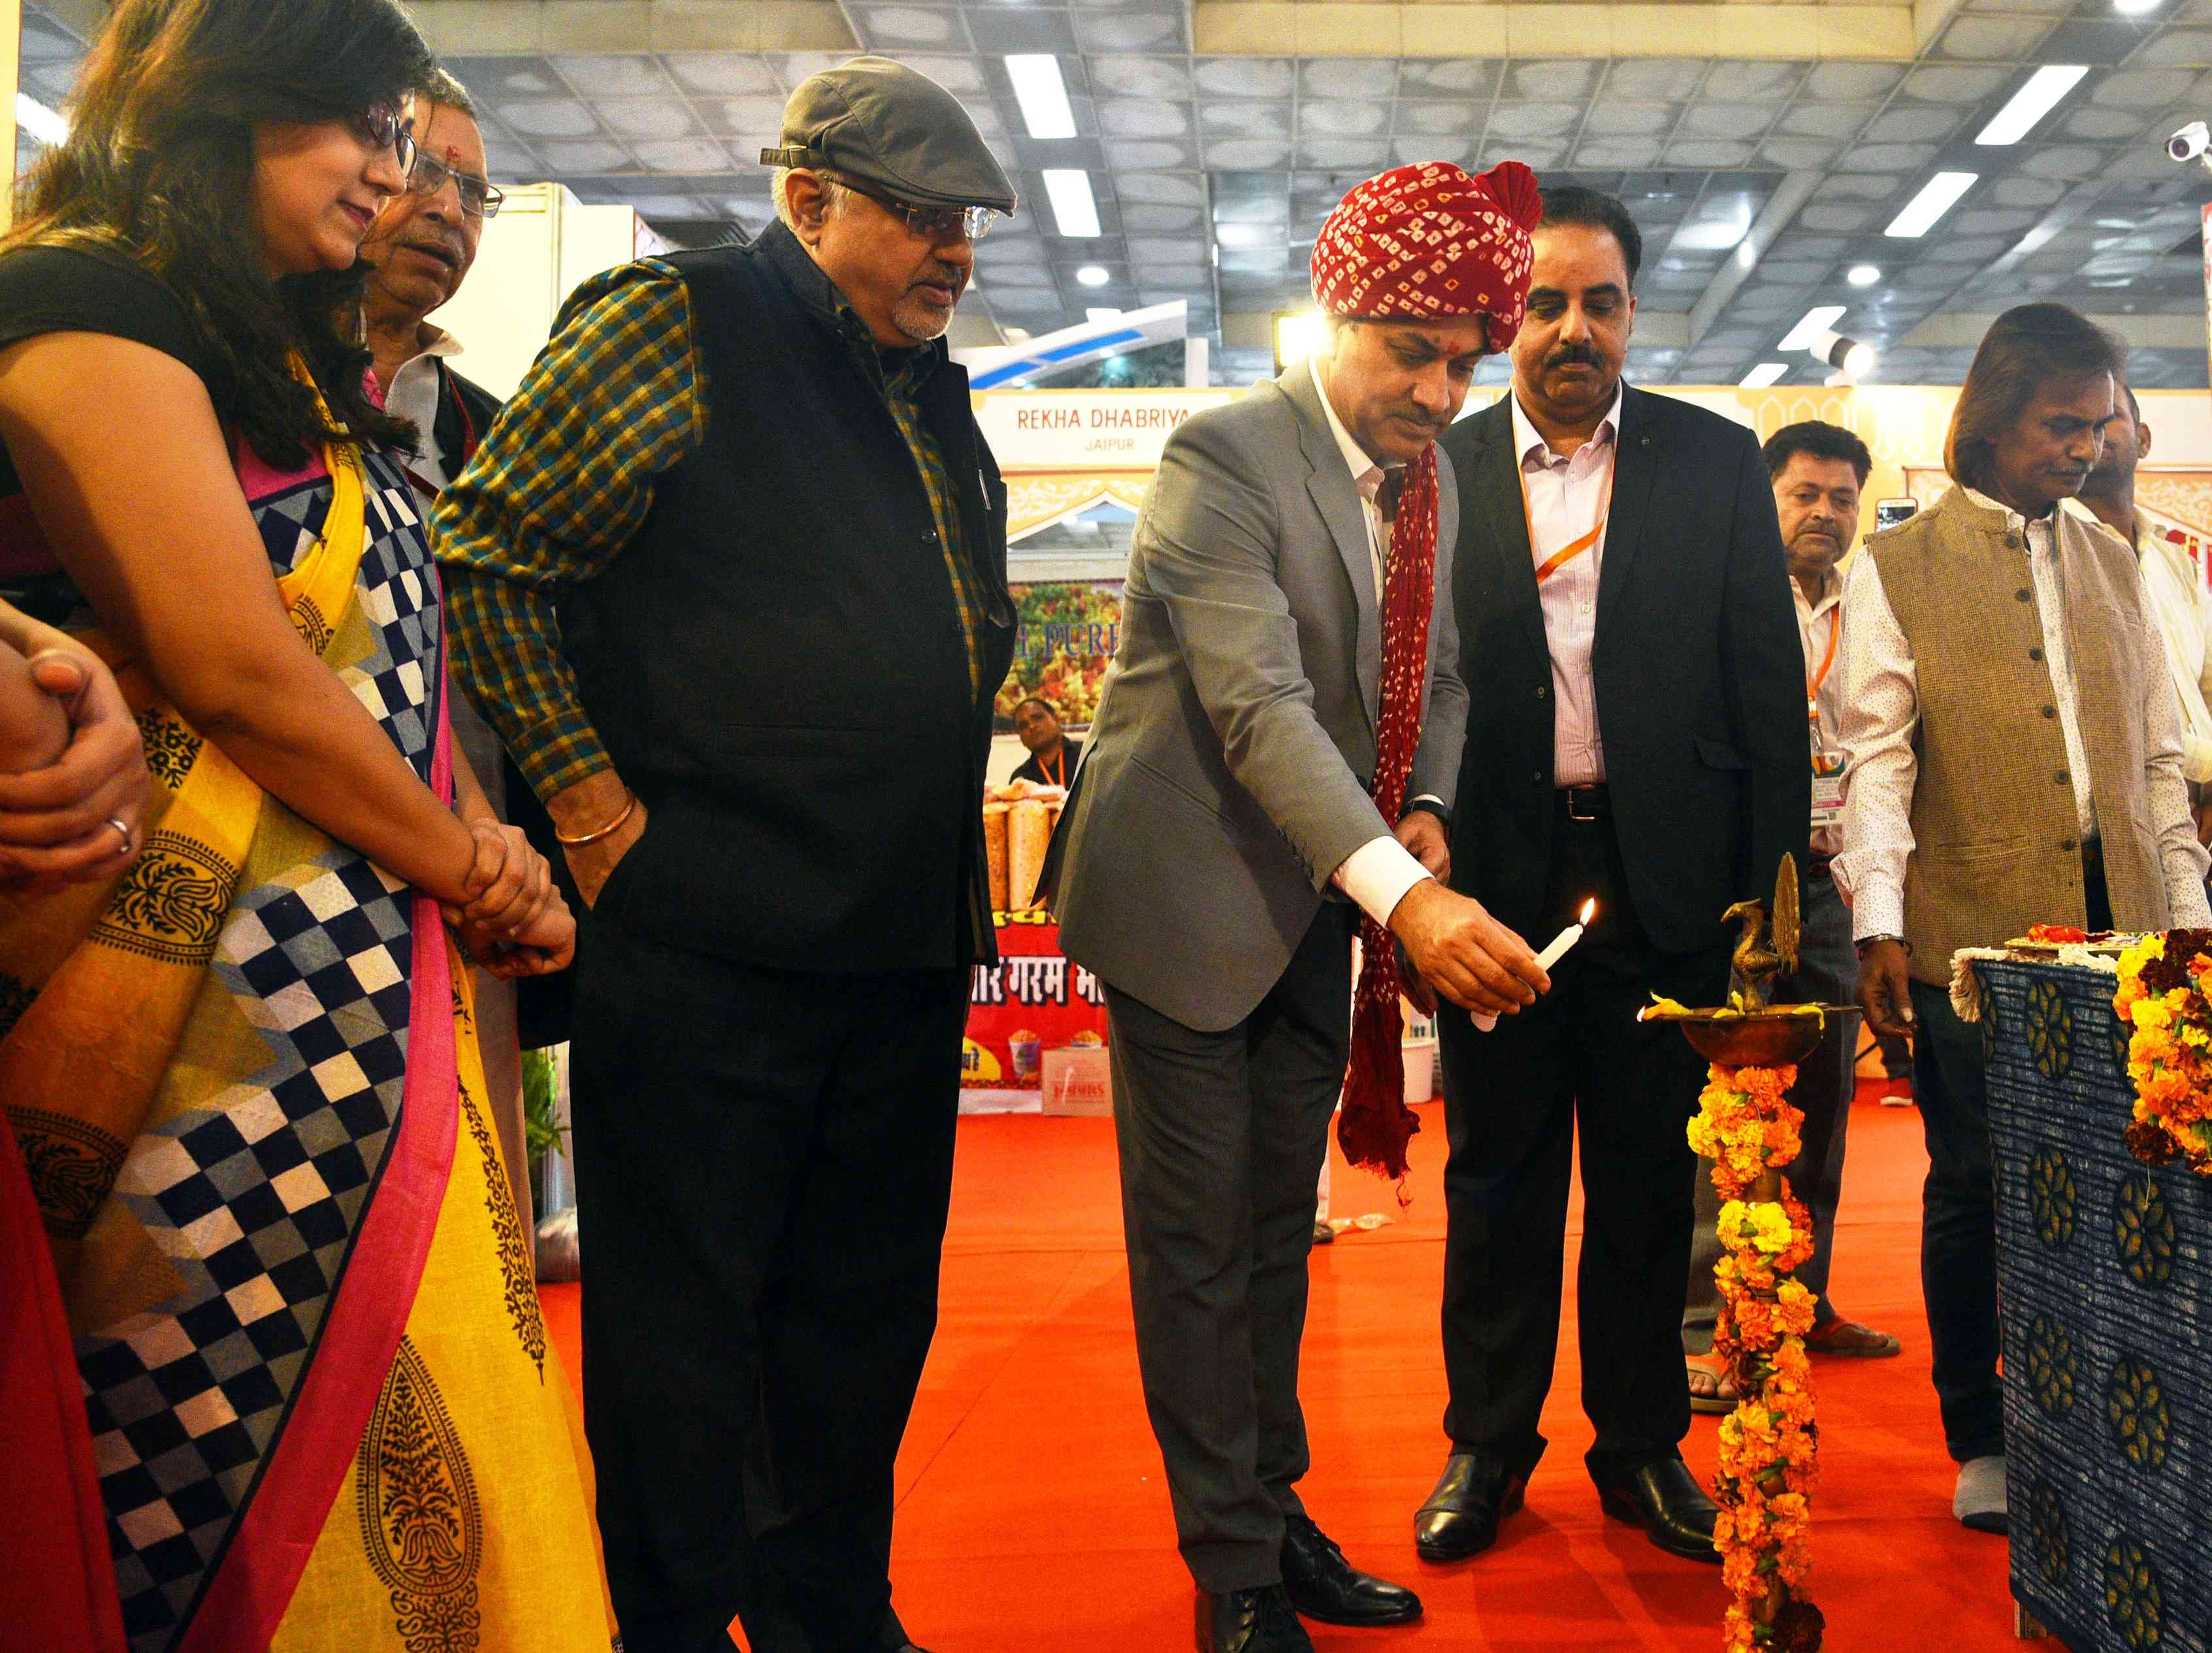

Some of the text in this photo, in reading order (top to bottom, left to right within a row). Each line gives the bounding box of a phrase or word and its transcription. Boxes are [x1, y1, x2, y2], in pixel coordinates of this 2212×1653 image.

[1018, 409, 1081, 429] REKHA
[1084, 438, 1135, 451] JAIPUR
[1009, 956, 1067, 1003] गरम
